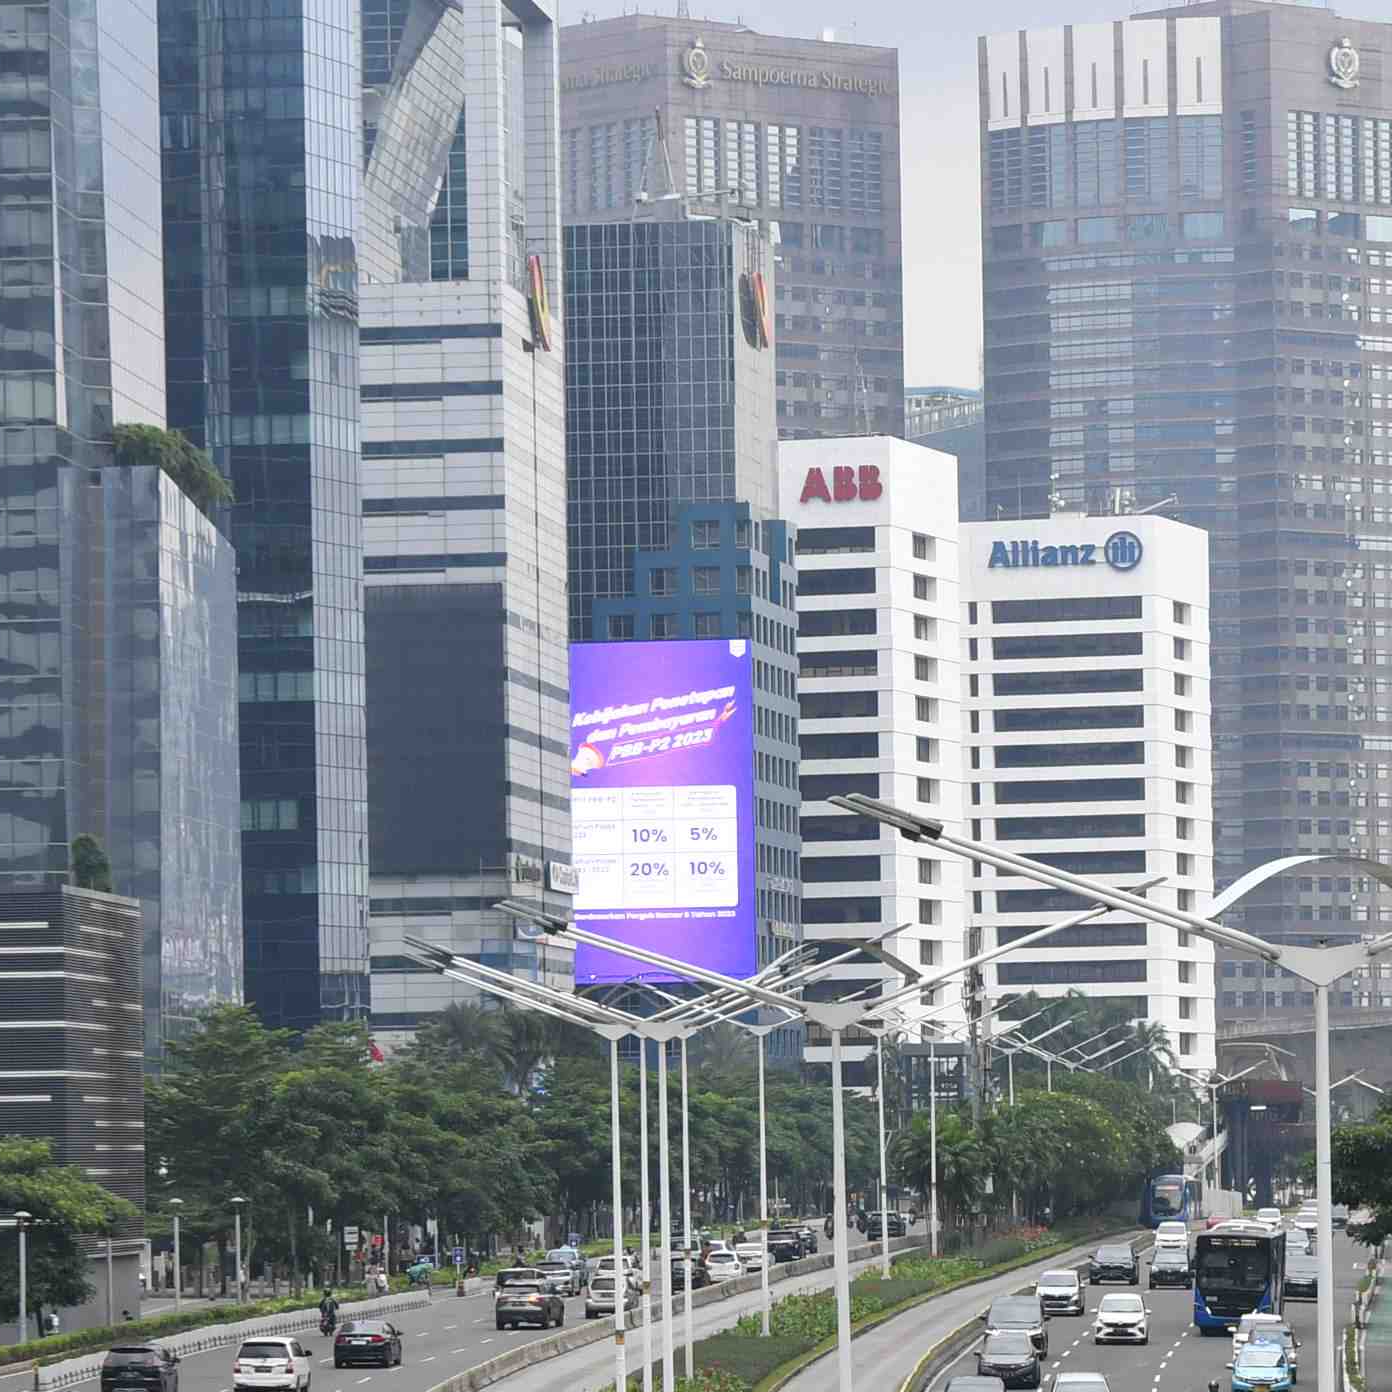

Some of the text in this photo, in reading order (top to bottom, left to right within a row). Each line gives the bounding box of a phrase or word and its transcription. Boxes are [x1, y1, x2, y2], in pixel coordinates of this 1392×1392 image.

[720, 59, 816, 88] Sampoerna
[799, 465, 883, 503] ABB
[987, 539, 1096, 569] Allianz
[631, 828, 668, 843] 10%
[689, 827, 718, 841] 5%
[630, 862, 670, 877] 20%
[689, 861, 726, 875] 10%
